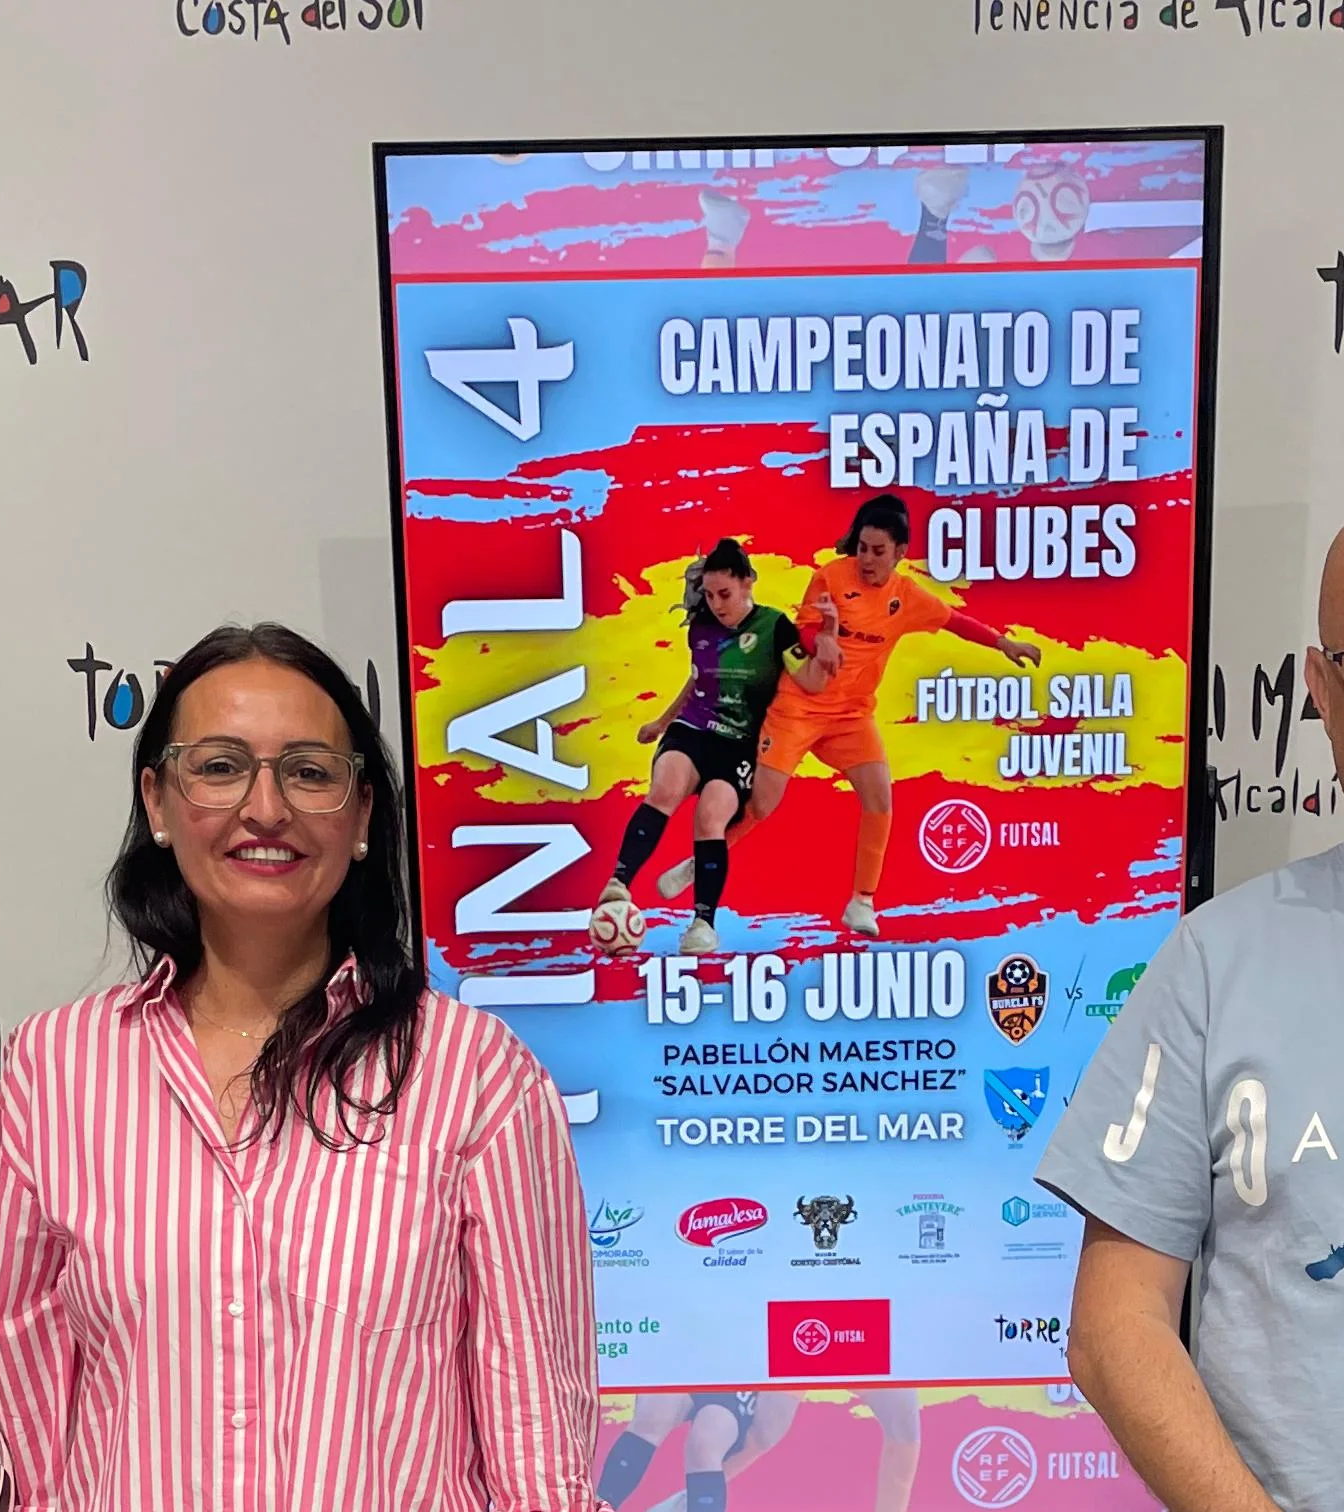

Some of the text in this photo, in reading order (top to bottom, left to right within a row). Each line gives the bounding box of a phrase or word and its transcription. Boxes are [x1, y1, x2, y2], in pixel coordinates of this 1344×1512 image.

[1159, 0, 1199, 29] de
[658, 308, 1140, 394] CAMPEONATO DE
[424, 317, 574, 442] 4
[831, 393, 1138, 488] ESPAÑA DE
[928, 503, 1137, 582] CLUBES
[918, 668, 1133, 722] FÚTBOL SALA
[999, 733, 1132, 778] JUVENIL
[1000, 821, 1060, 847] FUTSAL
[638, 950, 965, 1025] 15-16 JUNIO
[1065, 987, 1083, 1000] VS
[664, 1036, 956, 1066] PABELLÓN MAESTRO
[657, 1112, 963, 1145] TORRE DEL MAR
[684, 1202, 764, 1238] famadesa
[703, 1256, 747, 1267] Calidad
[596, 1317, 660, 1334] ento de
[834, 1329, 865, 1343] FUTSAL
[598, 1343, 628, 1358] aga
[1048, 1452, 1119, 1480] FUTSAL
